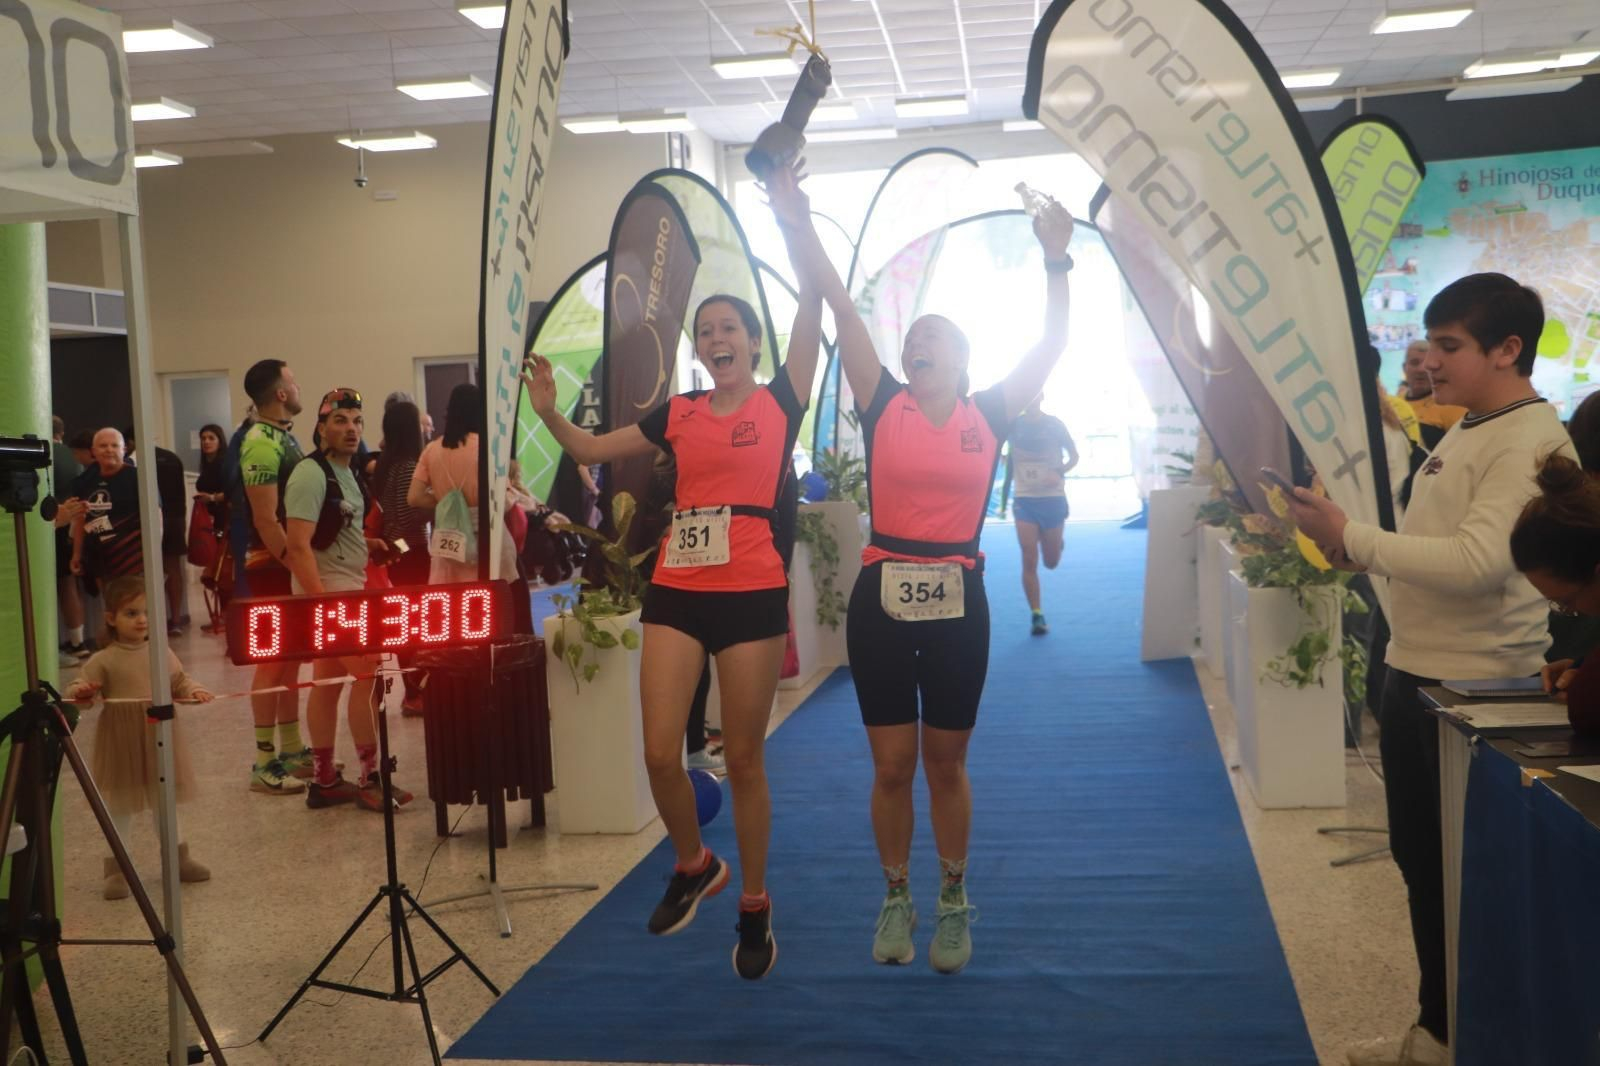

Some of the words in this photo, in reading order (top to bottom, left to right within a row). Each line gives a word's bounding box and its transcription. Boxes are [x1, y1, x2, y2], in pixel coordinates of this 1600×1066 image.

[1479, 164, 1574, 187] Hinojosa
[645, 216, 670, 321] TRESORO
[440, 538, 460, 553] 262
[678, 525, 710, 550] 351
[899, 581, 947, 604] 354
